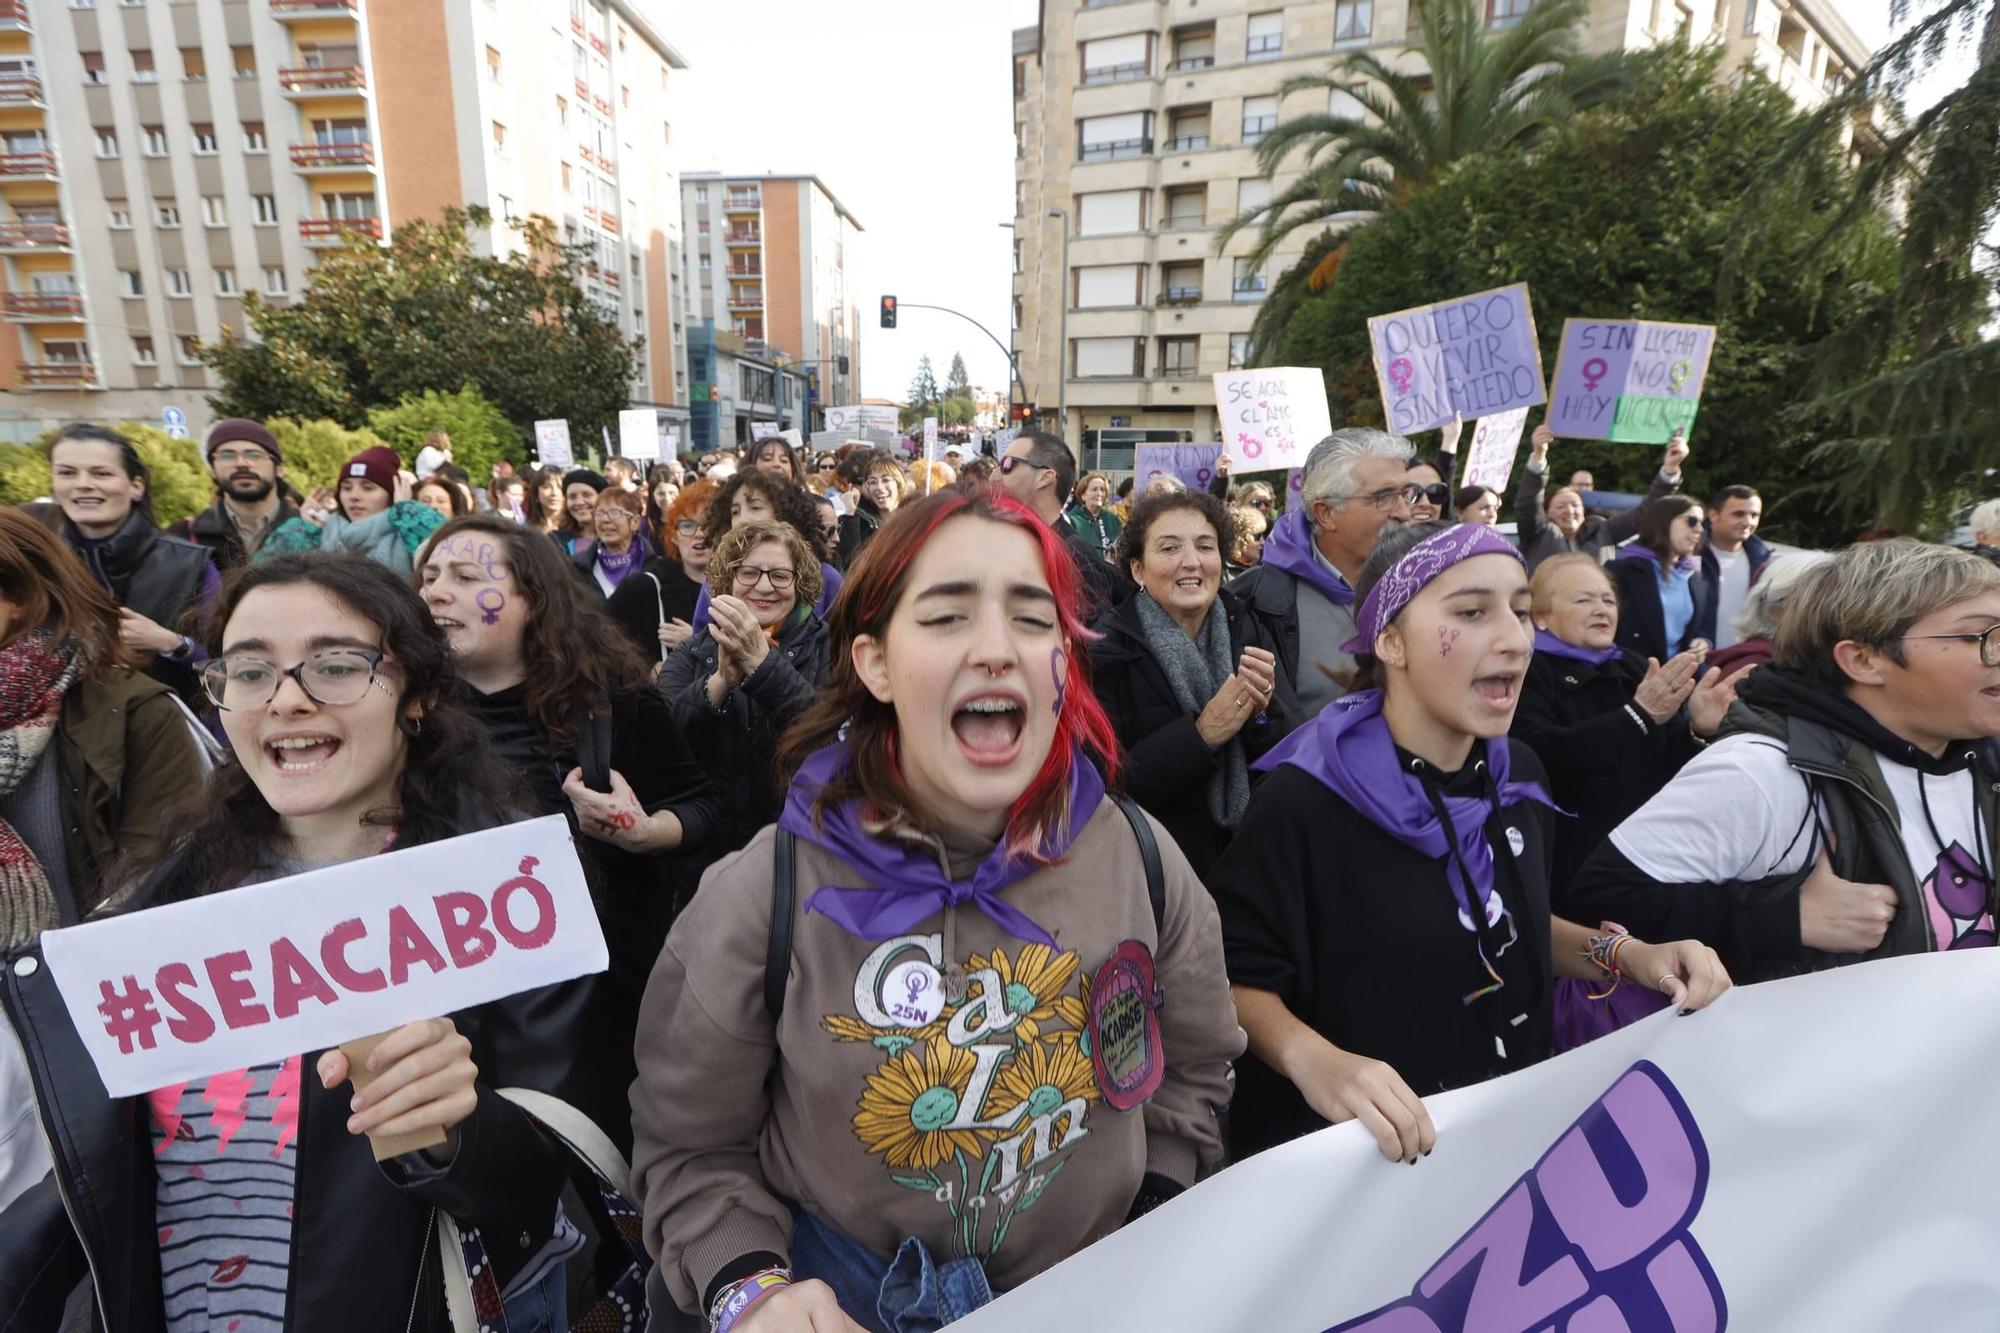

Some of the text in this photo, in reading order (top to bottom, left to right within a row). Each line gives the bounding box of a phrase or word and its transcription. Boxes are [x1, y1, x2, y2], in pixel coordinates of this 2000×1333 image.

[1384, 295, 1515, 355] QUIERO
[1579, 325, 1698, 355] SIN LUCHA
[1423, 334, 1509, 389] VIVIR
[1630, 360, 1666, 388] NO
[1227, 380, 1253, 404] SE
[1393, 364, 1536, 430] SIN MIEDO
[1240, 408, 1261, 424] EL
[1562, 394, 1612, 423] HAY
[97, 855, 557, 1056] #SEACABÓ
[891, 1003, 928, 1023] 25N
